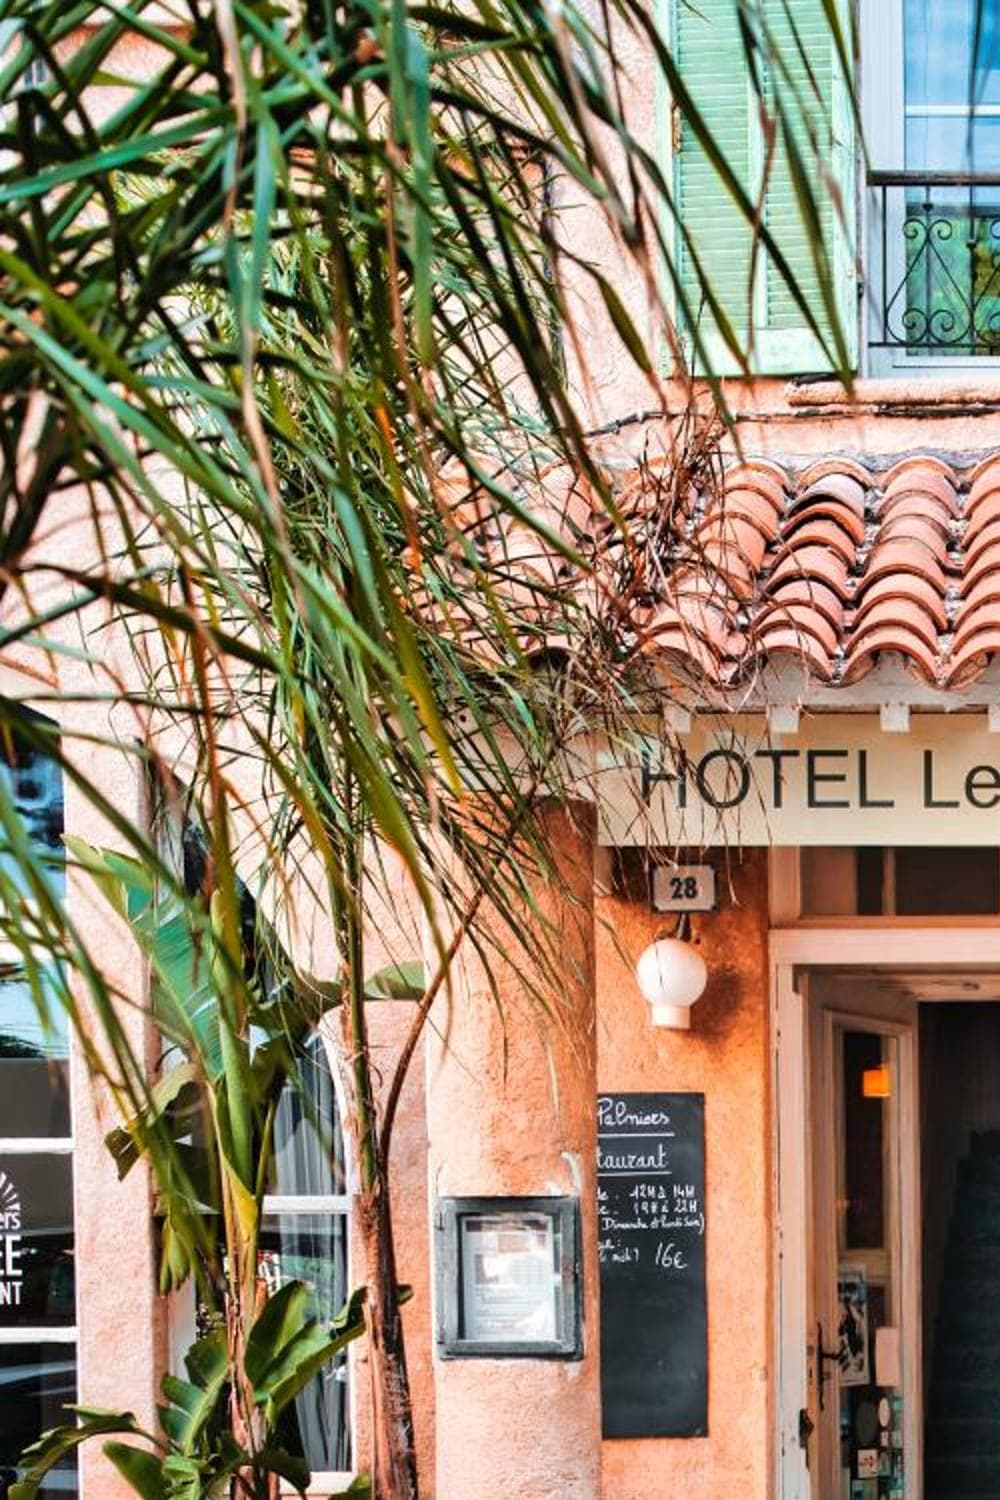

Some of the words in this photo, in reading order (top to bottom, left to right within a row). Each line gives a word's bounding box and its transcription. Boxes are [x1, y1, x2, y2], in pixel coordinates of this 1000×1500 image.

[641, 750, 895, 809] HOTEL
[669, 877, 698, 900] 28
[597, 1097, 670, 1127] Palmiers
